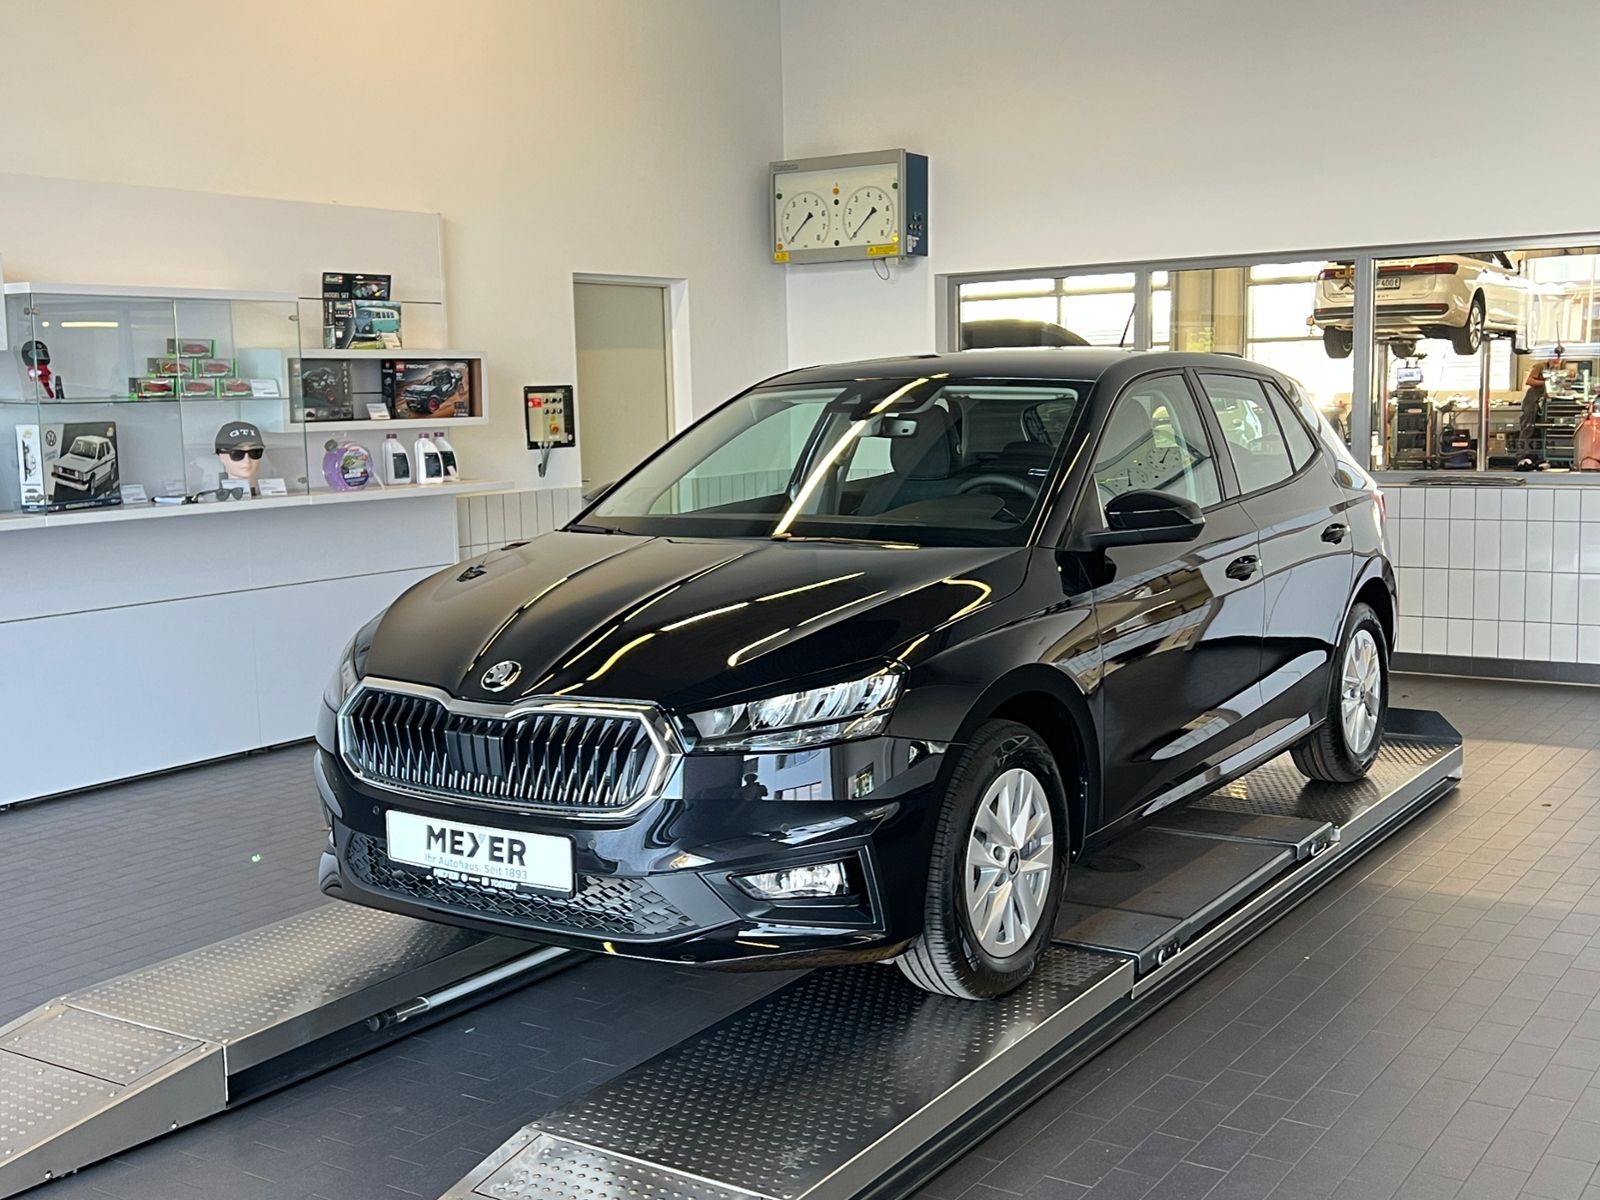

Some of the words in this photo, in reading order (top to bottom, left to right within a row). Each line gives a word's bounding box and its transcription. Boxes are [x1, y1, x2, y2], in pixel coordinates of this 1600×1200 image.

[229, 428, 256, 438] GTI
[425, 824, 527, 867] MEYER
[425, 852, 437, 864] Ihr
[438, 855, 482, 873] Autohaus.
[484, 864, 502, 876] Seit
[505, 867, 528, 880] 1893
